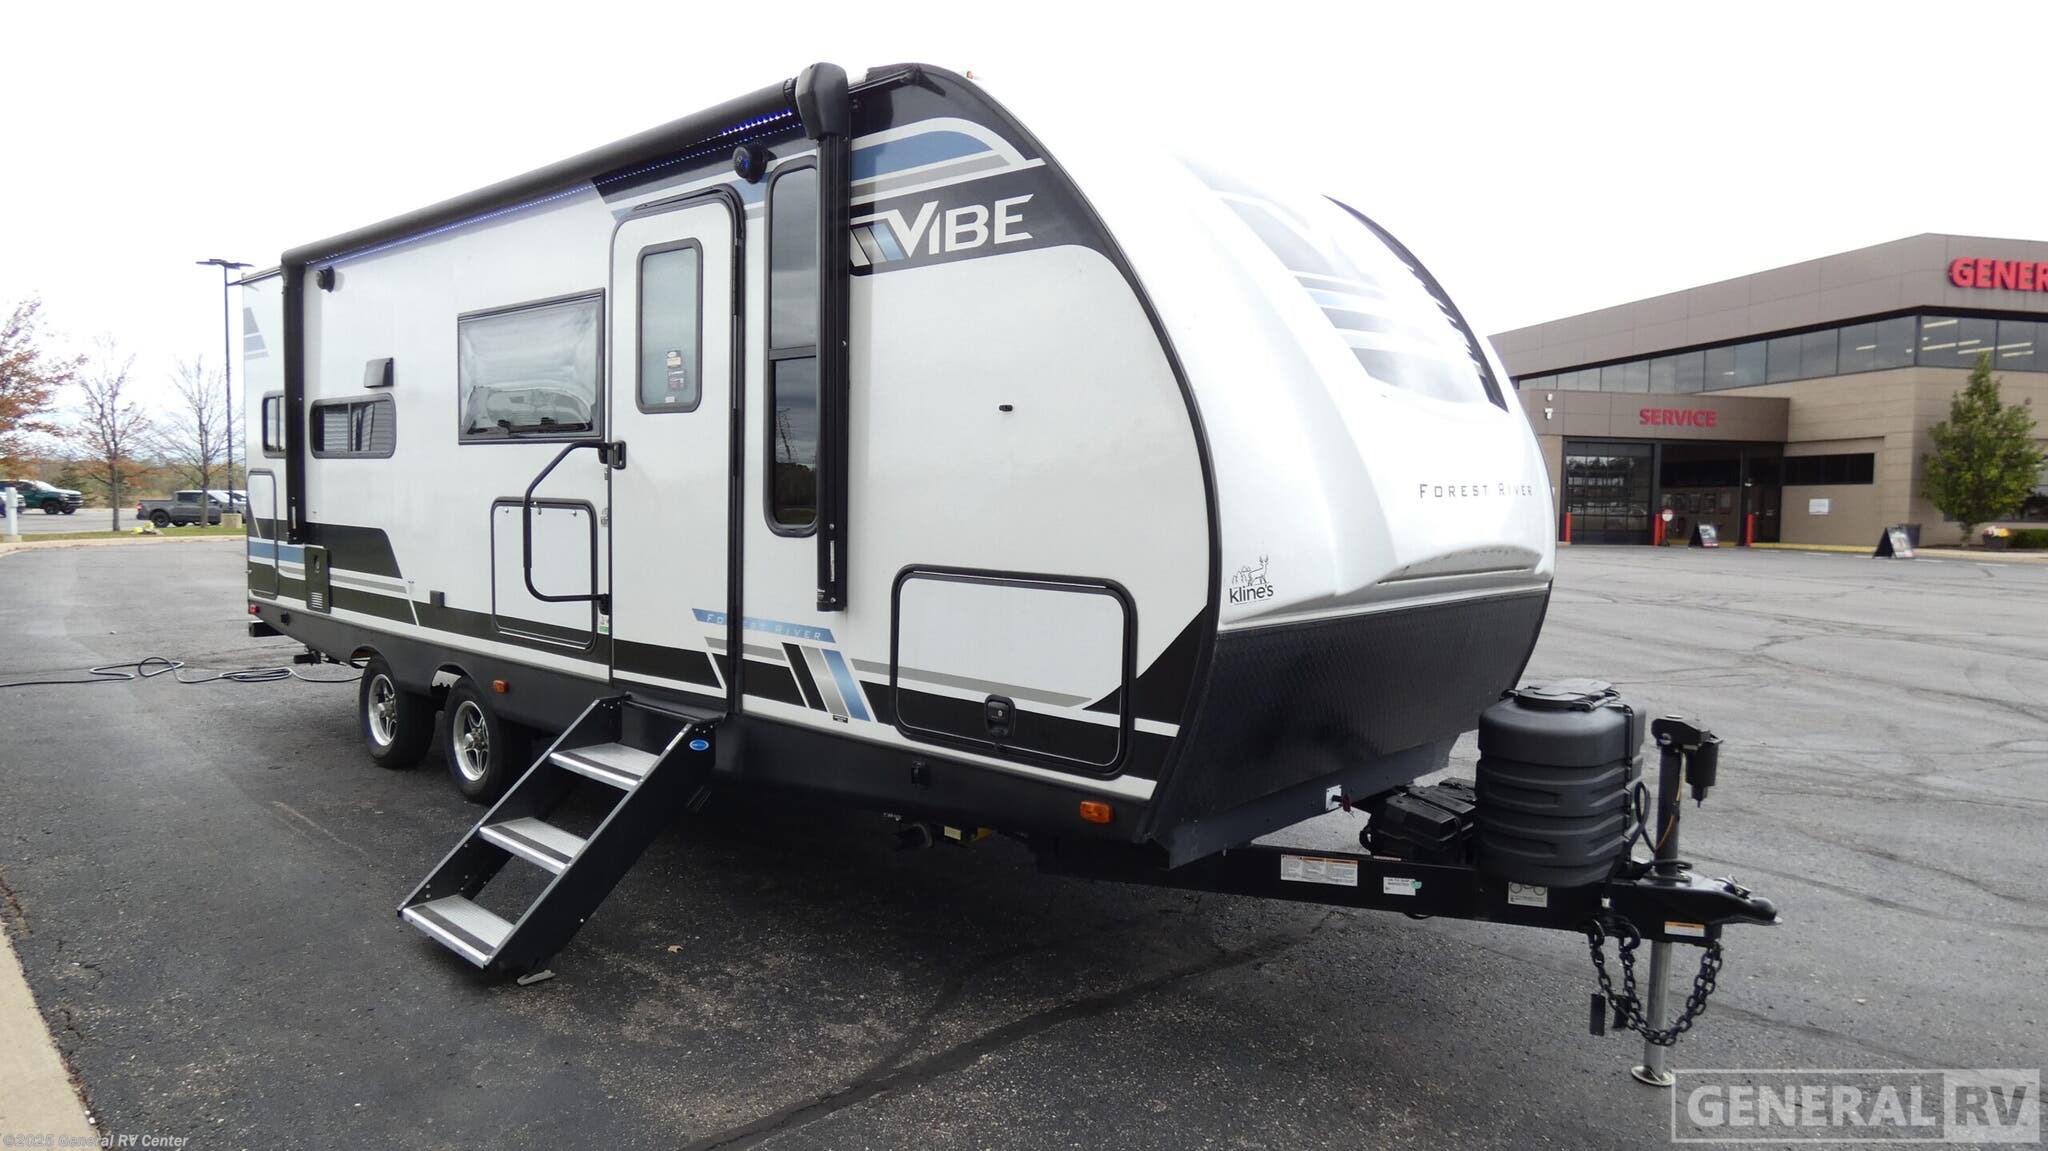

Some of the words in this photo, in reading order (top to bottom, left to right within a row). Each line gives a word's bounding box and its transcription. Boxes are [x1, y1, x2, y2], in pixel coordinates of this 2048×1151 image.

[887, 193, 1034, 258] VIBE
[1948, 256, 2048, 292] GENER
[1640, 407, 1718, 427] SERVICE
[1420, 483, 1488, 498] FOREST
[1498, 482, 1532, 496] RIVER
